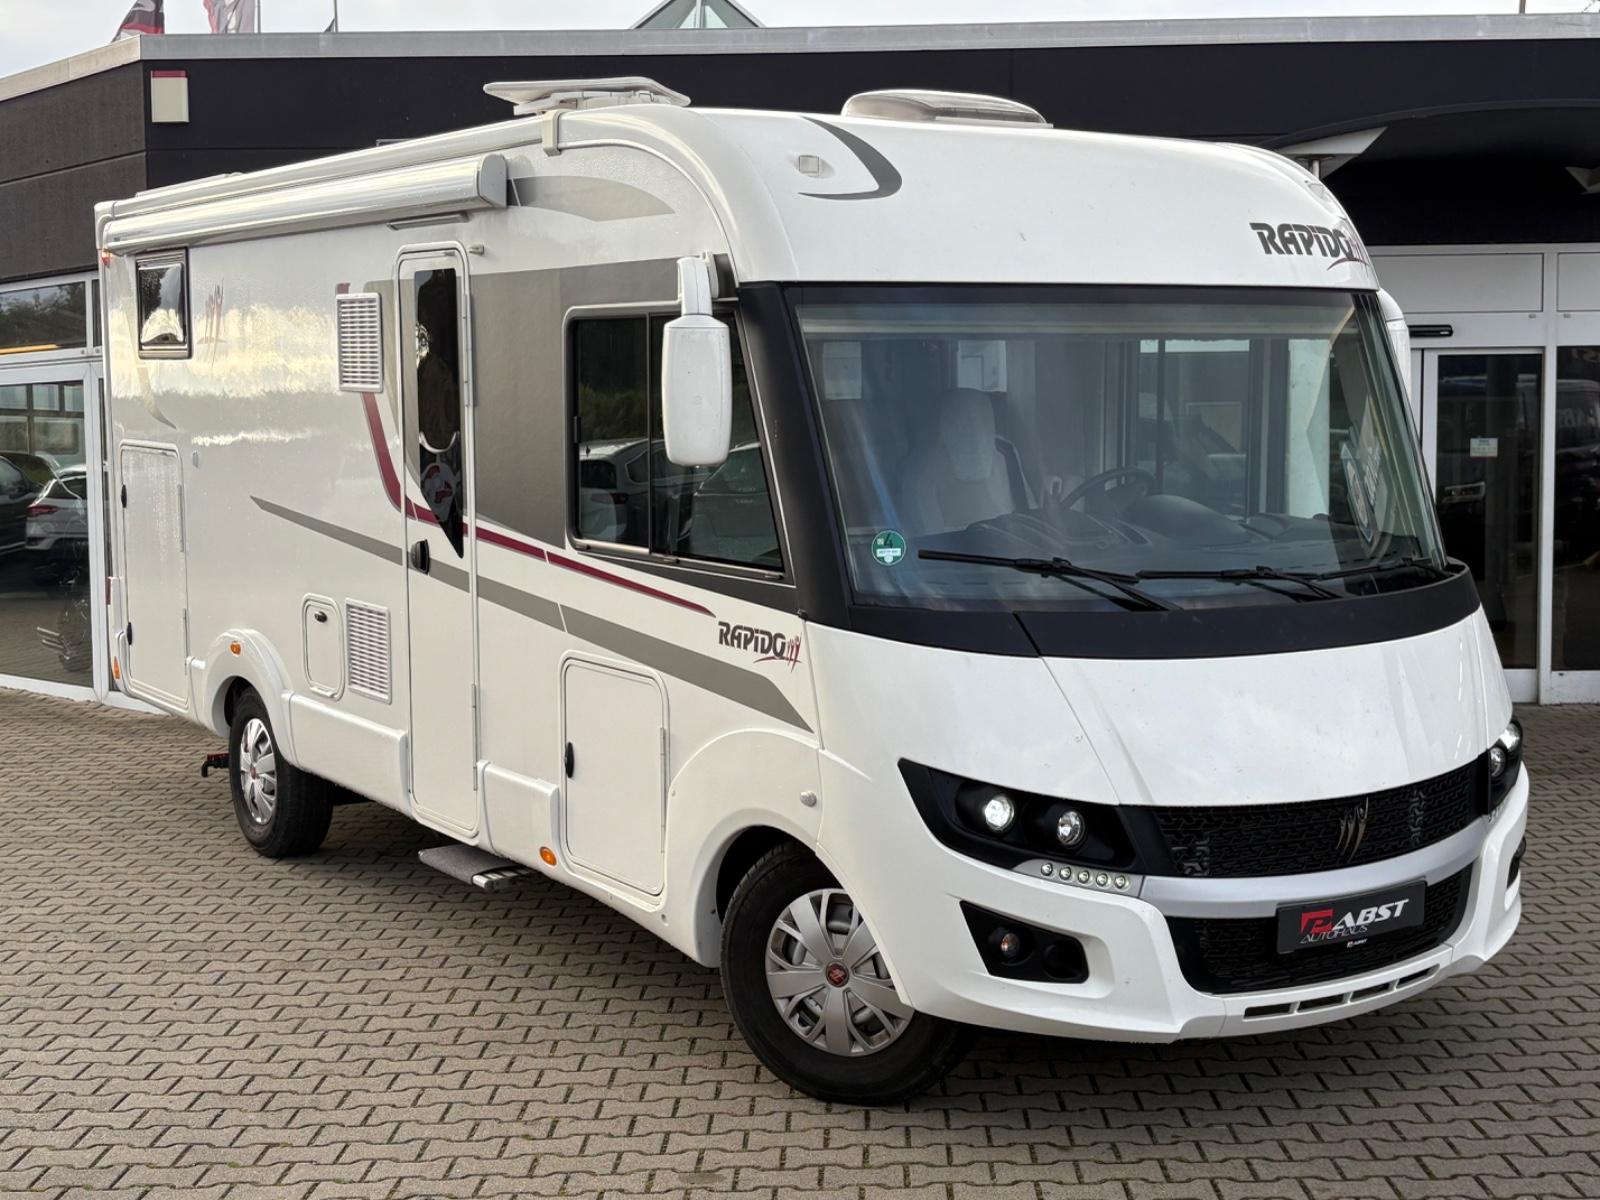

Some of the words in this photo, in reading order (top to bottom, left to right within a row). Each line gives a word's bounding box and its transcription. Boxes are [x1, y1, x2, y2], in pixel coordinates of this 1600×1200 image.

[1249, 222, 1356, 260] RAPIDO
[883, 532, 894, 548] 4
[718, 620, 786, 658] RAPIDO
[1300, 924, 1368, 944] AUTOHAUS
